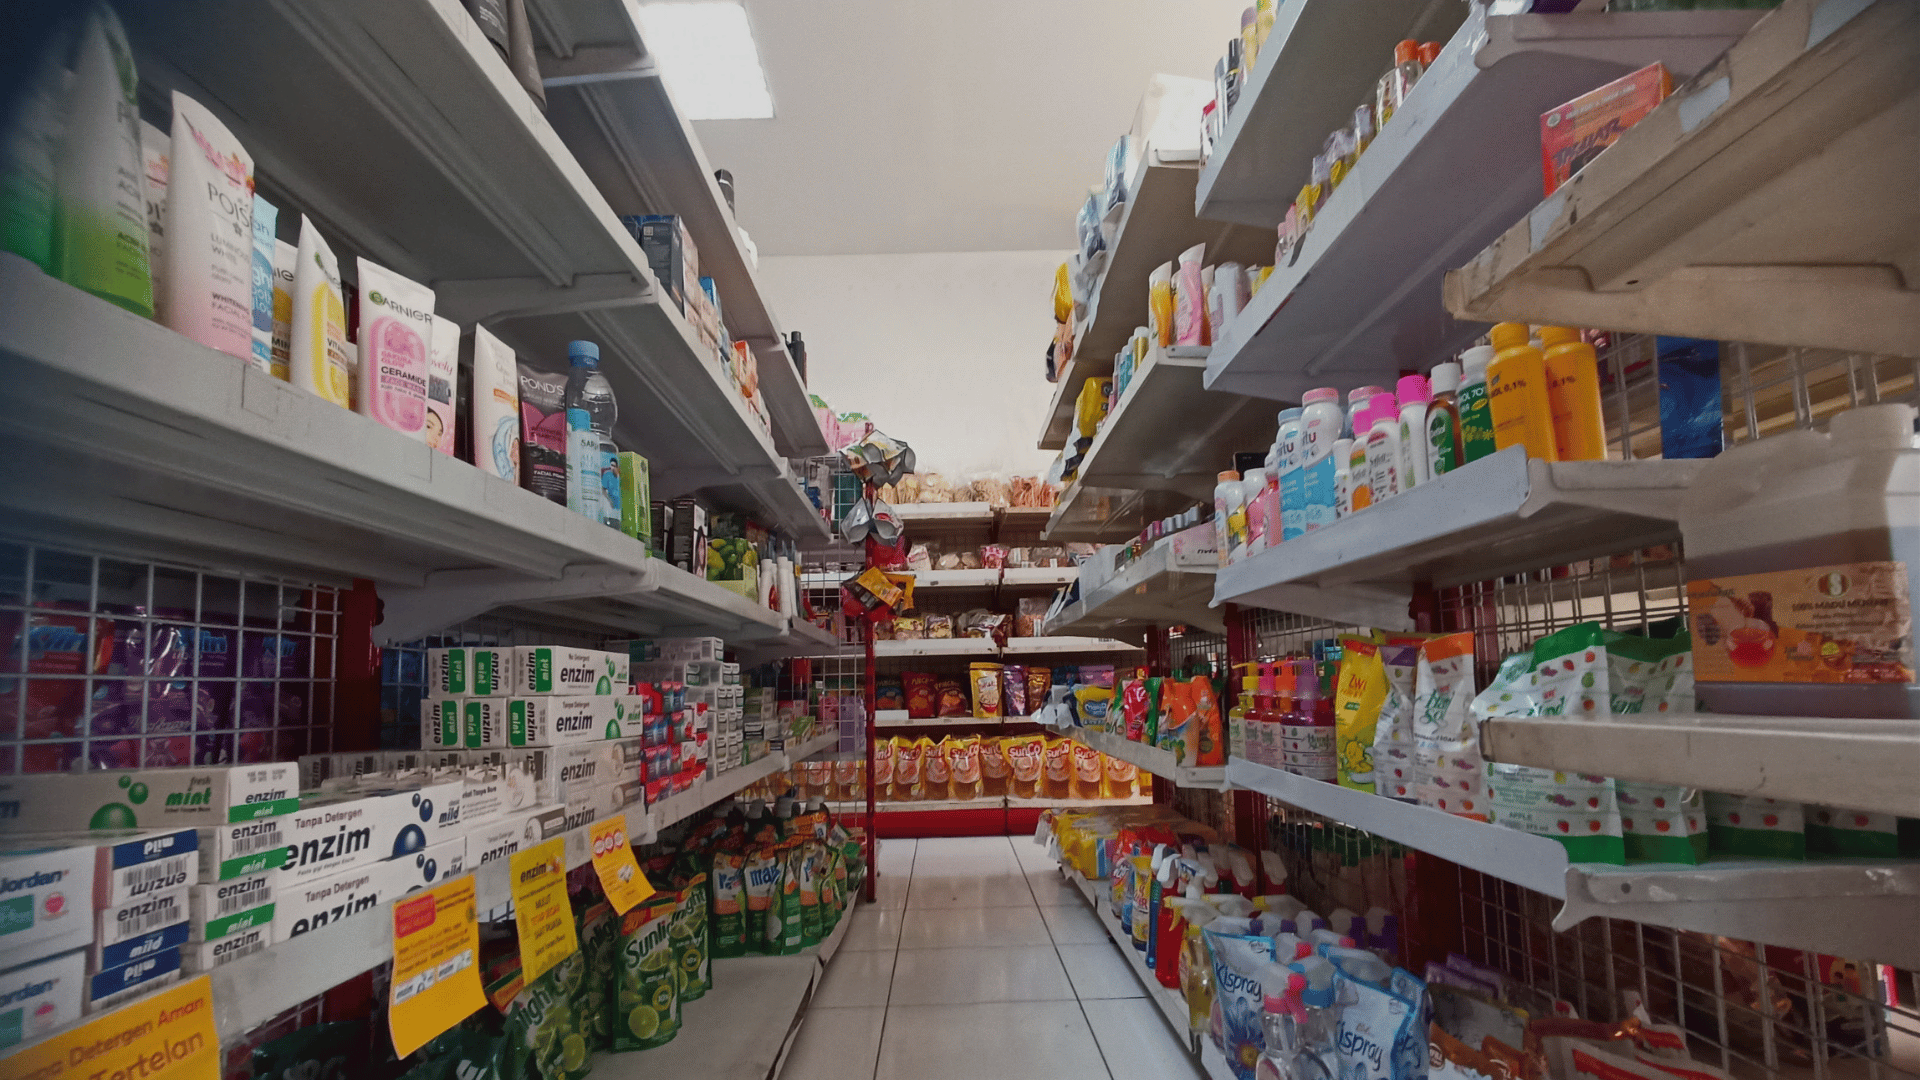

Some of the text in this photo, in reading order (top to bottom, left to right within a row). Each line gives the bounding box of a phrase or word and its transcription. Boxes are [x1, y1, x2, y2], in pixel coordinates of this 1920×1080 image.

[369, 290, 433, 326] GARNIER
[381, 366, 426, 388] CERAMIDE
[520, 375, 565, 396] POND'S
[441, 653, 450, 692] enzim
[491, 652, 501, 691] enzim
[526, 652, 536, 691] enzim
[560, 664, 595, 683] enzim
[431, 704, 441, 744] enzim
[483, 703, 493, 743] enzim
[526, 702, 538, 741] enzim
[556, 711, 593, 732] enzim
[561, 758, 597, 782] enzim
[187, 776, 212, 792] fresh
[165, 787, 212, 806] mint
[245, 788, 287, 804] enzim
[253, 805, 274, 817] mint
[295, 808, 363, 830] Tanpa Detergen
[439, 807, 460, 825] mild
[567, 806, 595, 831] nzim
[231, 820, 277, 840] enzim
[143, 836, 175, 856] mild
[279, 825, 372, 872] enzim
[481, 840, 518, 866] enzim
[239, 857, 267, 875] mint
[443, 864, 463, 880] mild
[520, 861, 548, 884] enzim
[130, 871, 187, 897] enzim
[217, 876, 267, 900] enzim
[305, 875, 371, 904] Tanpa Detergen
[117, 894, 175, 923] enzim
[289, 892, 378, 940] enzim
[226, 914, 254, 936] mint
[129, 936, 164, 959] mild
[213, 929, 260, 957] enzim
[123, 958, 157, 981] mild
[69, 1021, 153, 1068] Detergen
[158, 998, 204, 1027] Aman
